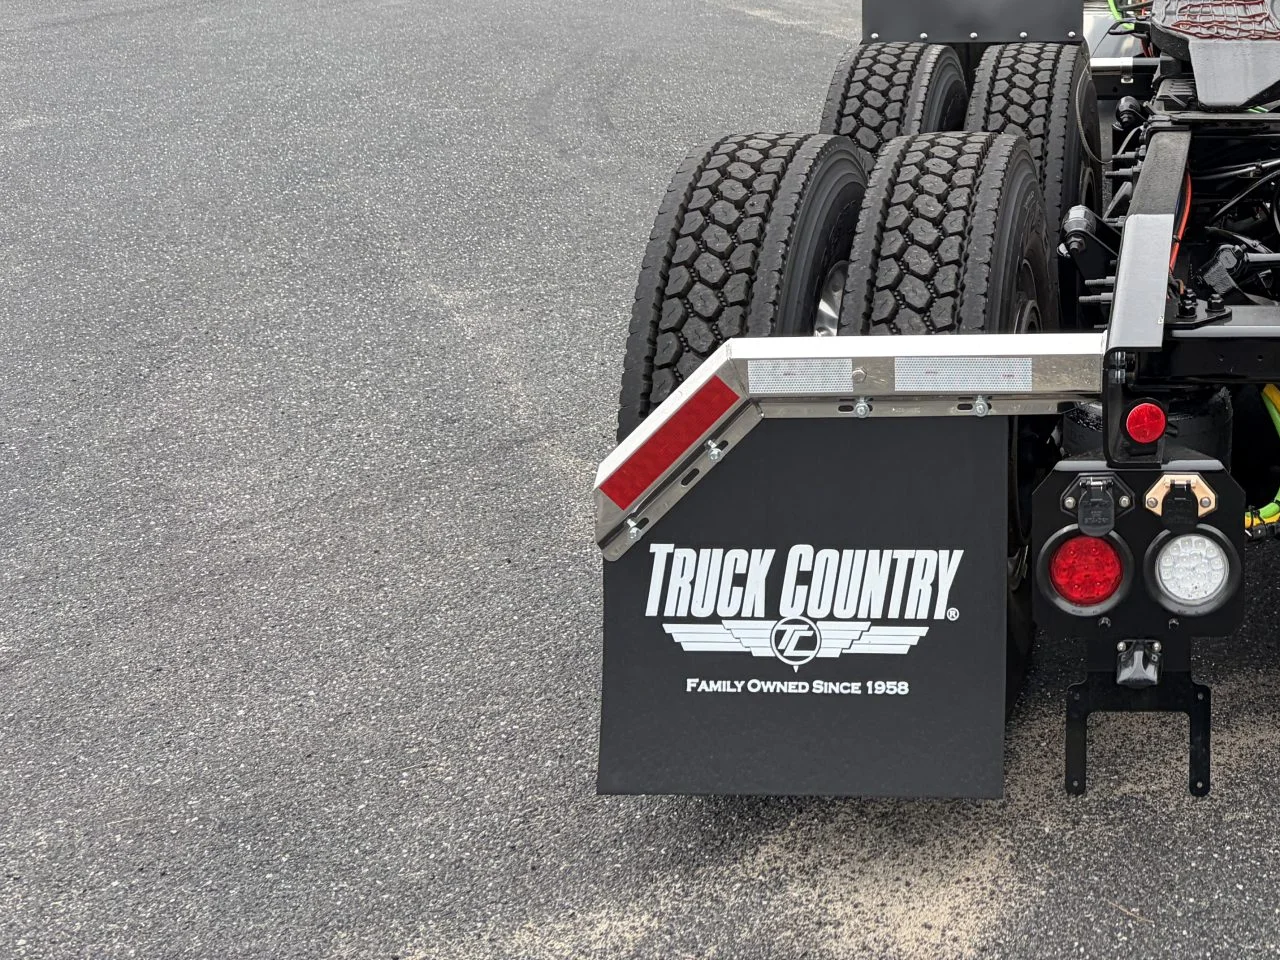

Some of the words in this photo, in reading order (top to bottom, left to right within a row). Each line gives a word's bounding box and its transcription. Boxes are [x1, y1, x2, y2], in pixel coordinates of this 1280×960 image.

[644, 543, 776, 617] TRUCK
[685, 677, 746, 693] FAMILY
[746, 678, 810, 694] OWNED
[811, 679, 862, 695] SINCE
[866, 680, 910, 696] 1958
